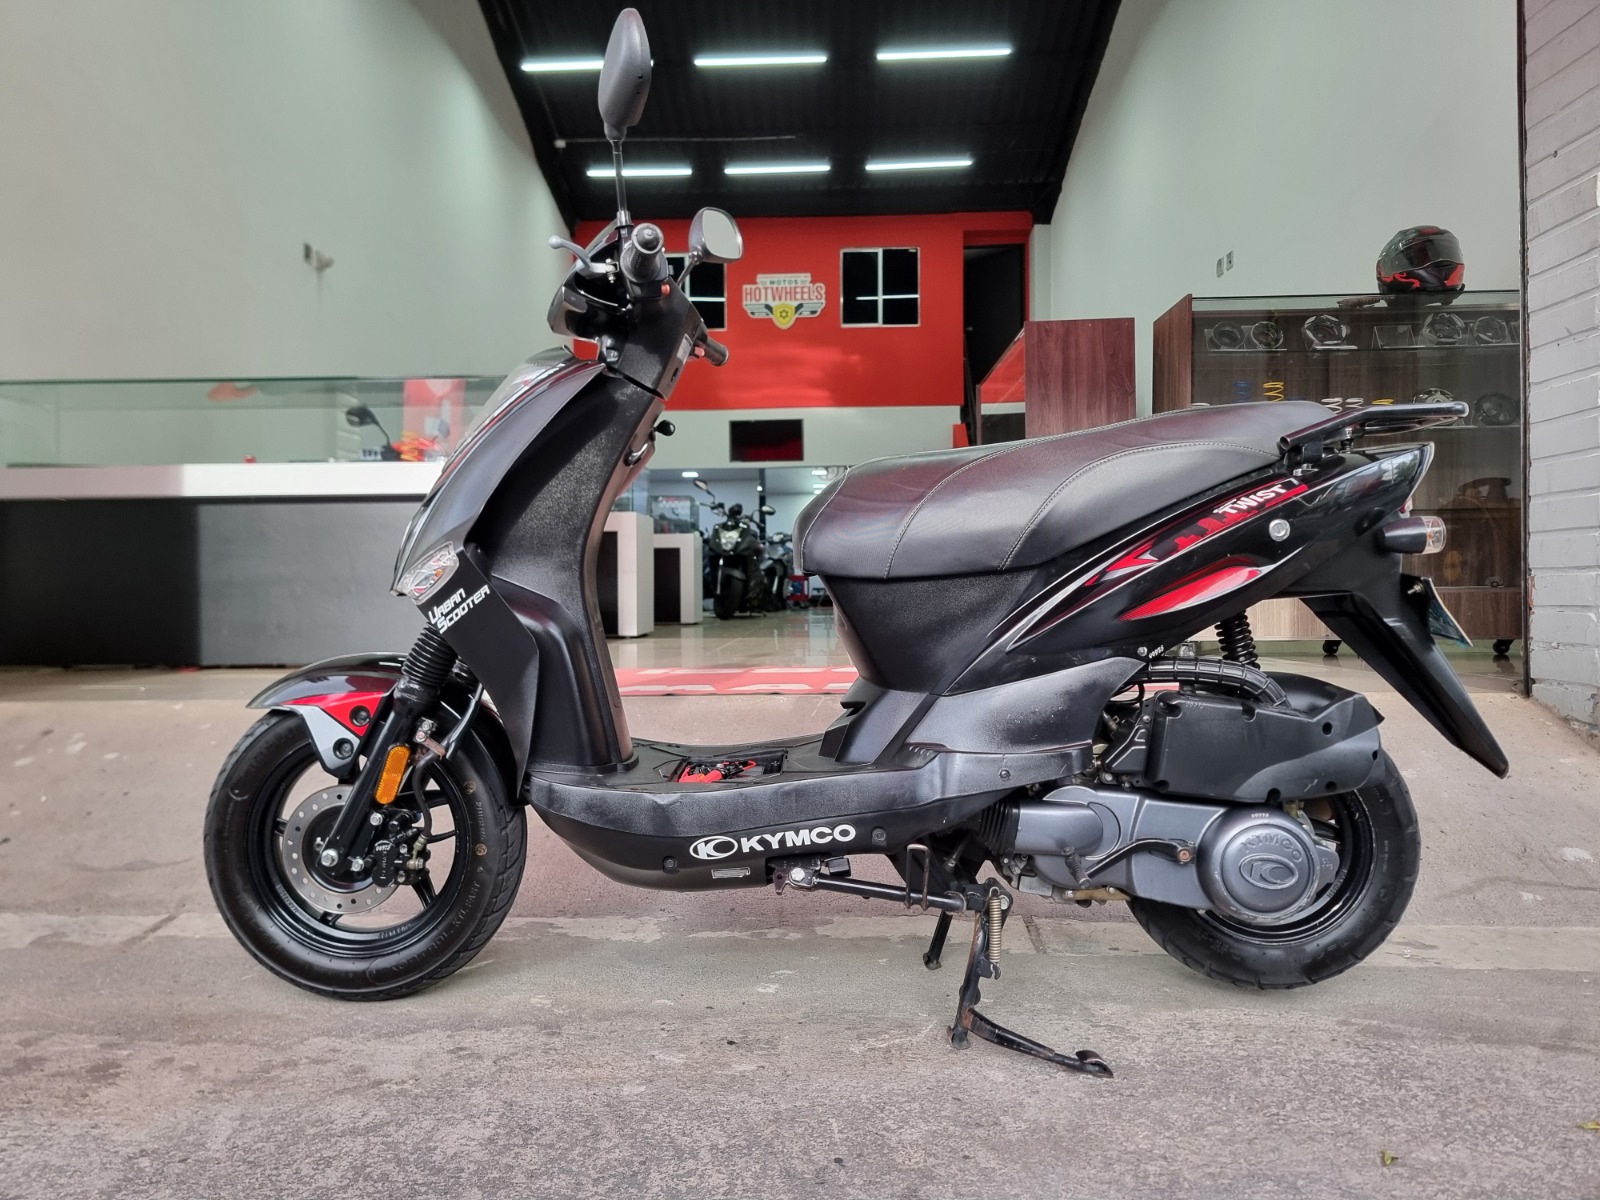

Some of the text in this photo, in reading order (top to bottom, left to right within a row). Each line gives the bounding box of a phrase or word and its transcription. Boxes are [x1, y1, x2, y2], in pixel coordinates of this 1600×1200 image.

[744, 286, 823, 302] HOTWHEELS
[1216, 484, 1287, 514] TWIST
[437, 585, 490, 634] SCOOTER
[740, 824, 856, 853] KYMCO
